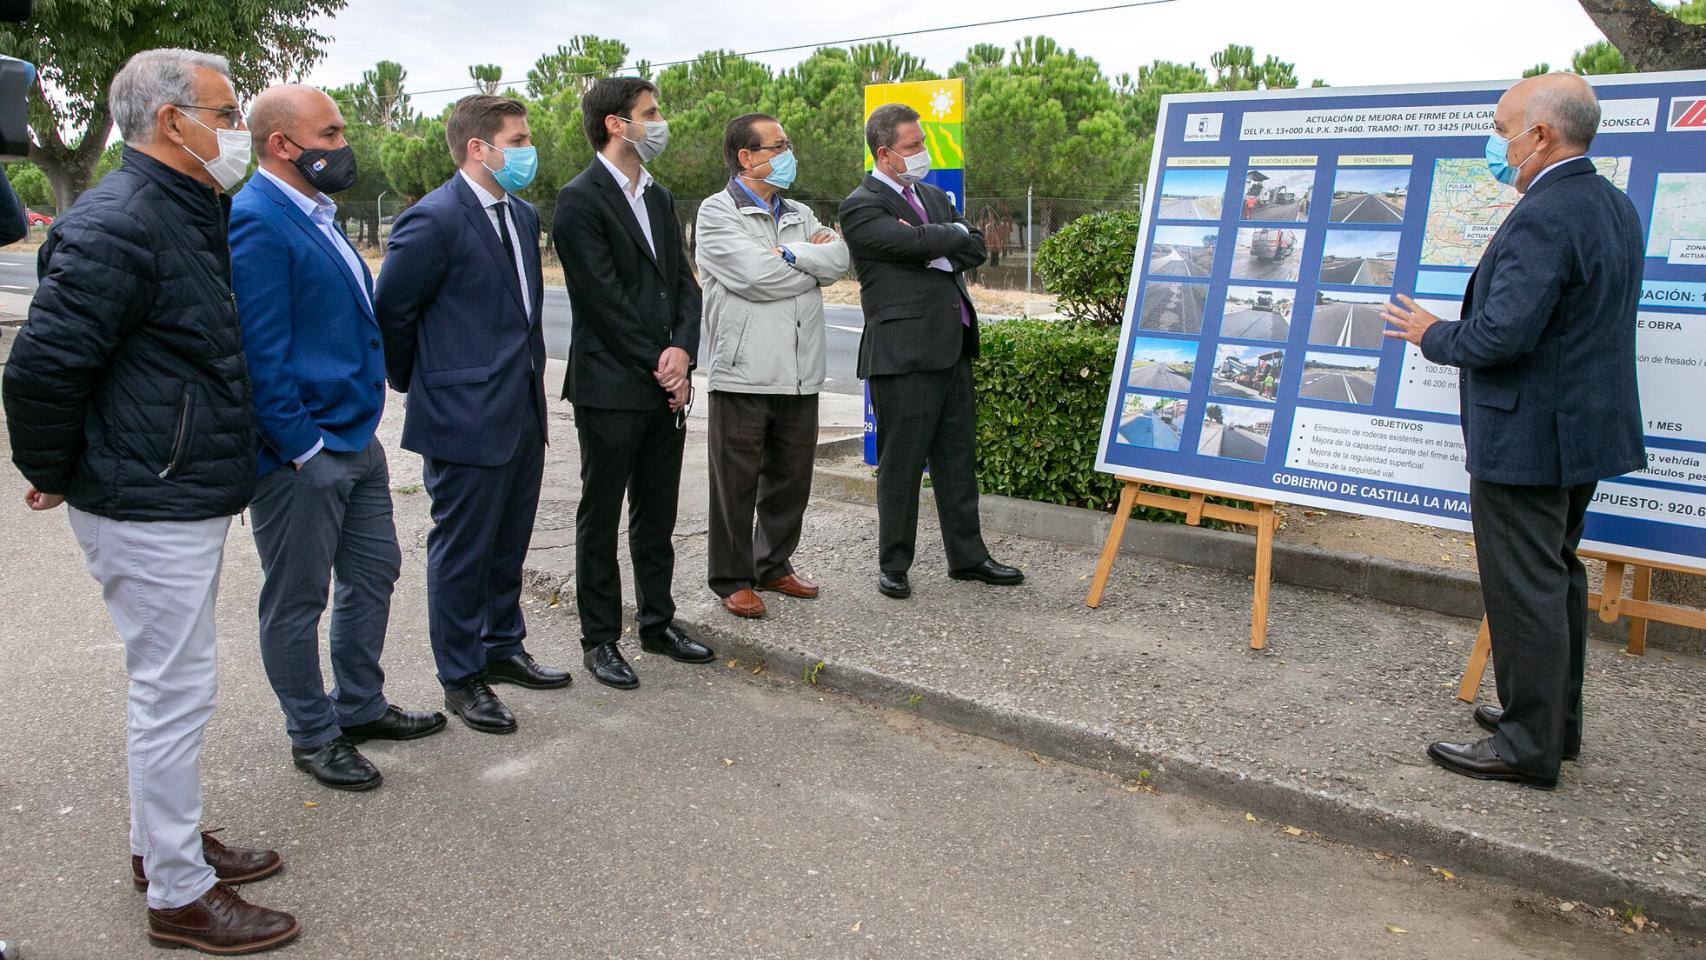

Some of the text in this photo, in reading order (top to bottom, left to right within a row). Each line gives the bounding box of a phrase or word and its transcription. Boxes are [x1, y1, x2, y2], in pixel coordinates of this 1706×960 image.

[1306, 113, 1353, 123] ACTUACIÓN
[1356, 114, 1368, 122] DE
[1419, 112, 1446, 120] FIRME
[1462, 111, 1474, 119] LA
[1276, 127, 1303, 135] 13+000
[1316, 126, 1331, 134] P.K.
[1368, 124, 1401, 132] TRAMO:
[1404, 124, 1420, 132] INT.
[1424, 124, 1435, 132] TO
[1438, 123, 1459, 131] 3425
[1462, 122, 1495, 131] (PULGA
[1602, 118, 1650, 127] SONSECA
[1648, 320, 1682, 330] OBRA
[1652, 356, 1662, 364] de
[1664, 356, 1696, 366] fresado
[1422, 379, 1446, 388] 46.200
[1370, 418, 1424, 432] OBJETIVOS
[1648, 420, 1682, 432] 1 MES
[1314, 423, 1350, 434] Eliminación
[1362, 430, 1388, 440] roderas
[1389, 434, 1424, 444] existentes
[1310, 447, 1331, 457] Mejora
[1350, 453, 1388, 464] regularidad
[1312, 435, 1334, 445] Mejora
[1352, 442, 1386, 452] capacidad
[1388, 446, 1416, 456] portante
[1418, 450, 1428, 458] del
[1430, 451, 1448, 460] firme
[1450, 454, 1458, 462] de
[1307, 458, 1328, 469] Mejora
[1330, 462, 1339, 470] de
[1348, 466, 1380, 476] seguridad
[1688, 472, 1706, 482] pes
[1272, 472, 1471, 514] GOBIERNO DE CASTILLA LA MA
[1591, 492, 1706, 516] UPUESTO: 920.6
